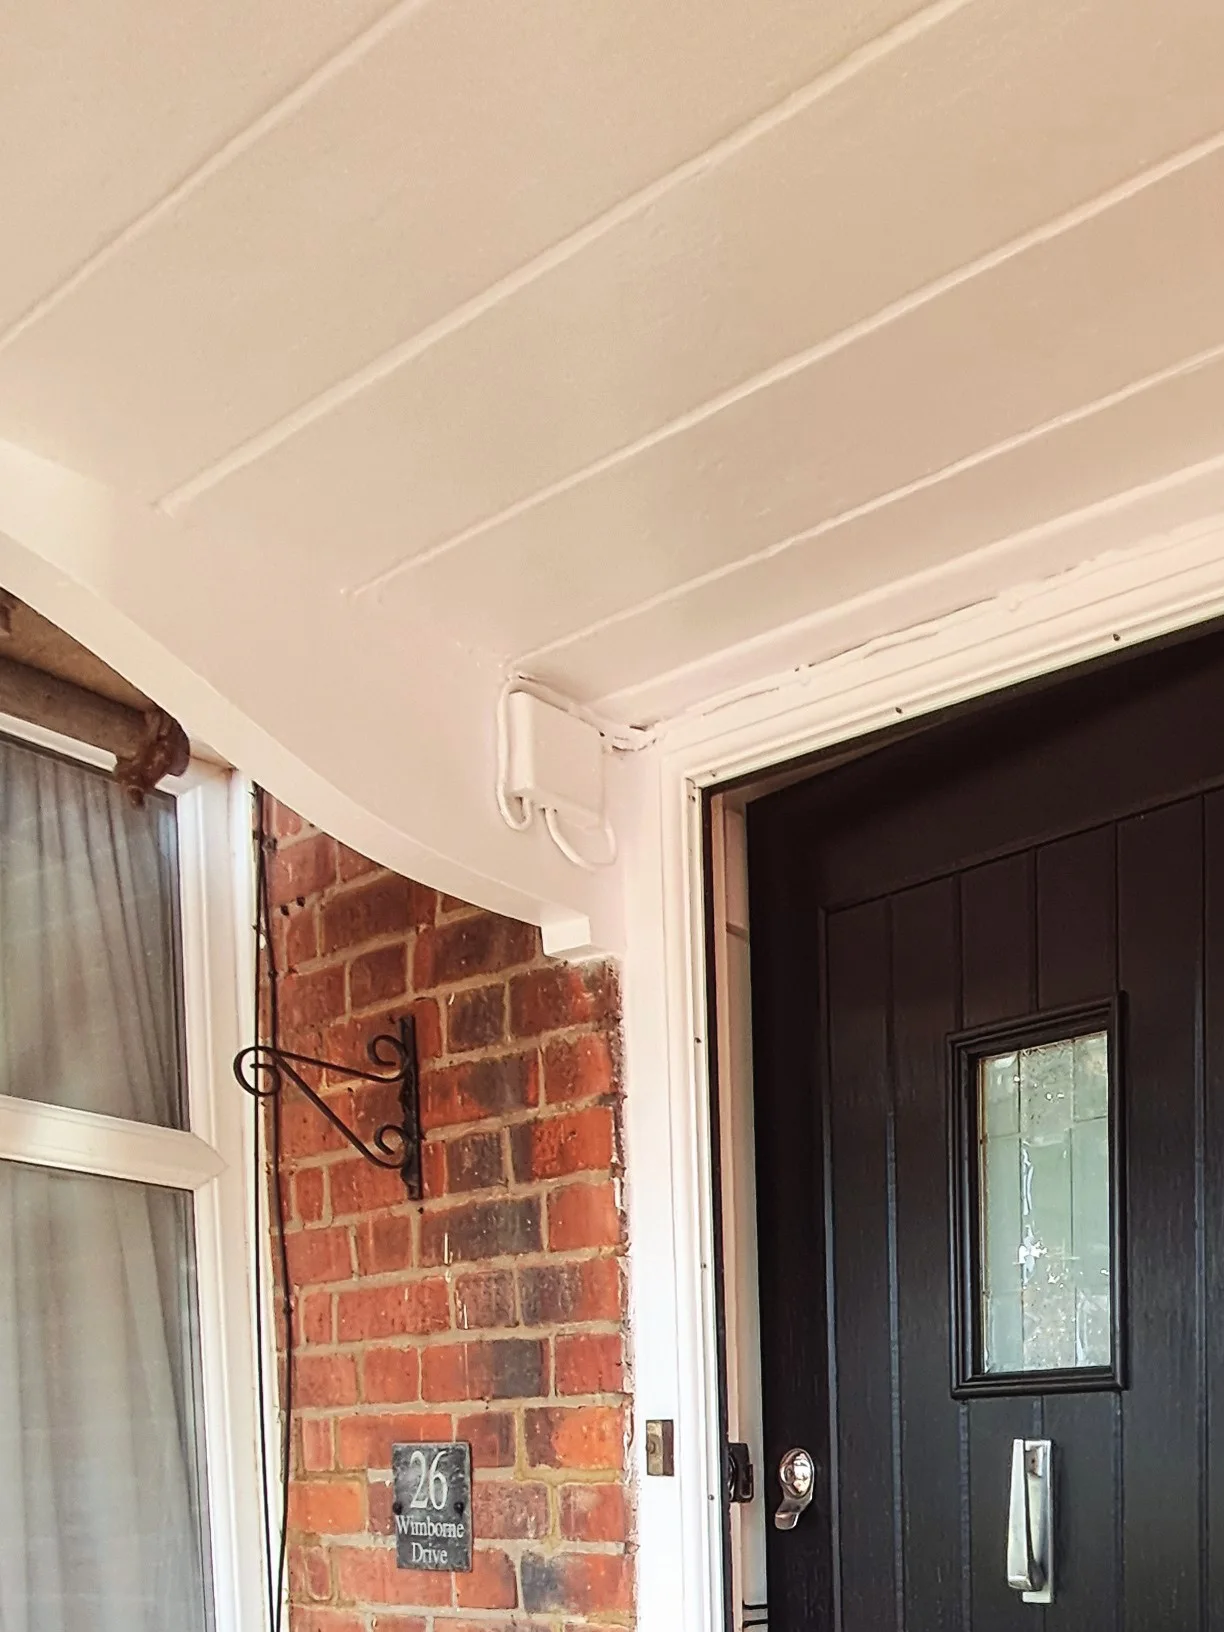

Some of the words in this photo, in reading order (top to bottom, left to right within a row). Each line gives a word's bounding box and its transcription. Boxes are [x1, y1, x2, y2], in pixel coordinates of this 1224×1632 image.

[410, 1451, 448, 1510] 26
[396, 1515, 464, 1538] Wimborne
[412, 1542, 448, 1564] Drive
